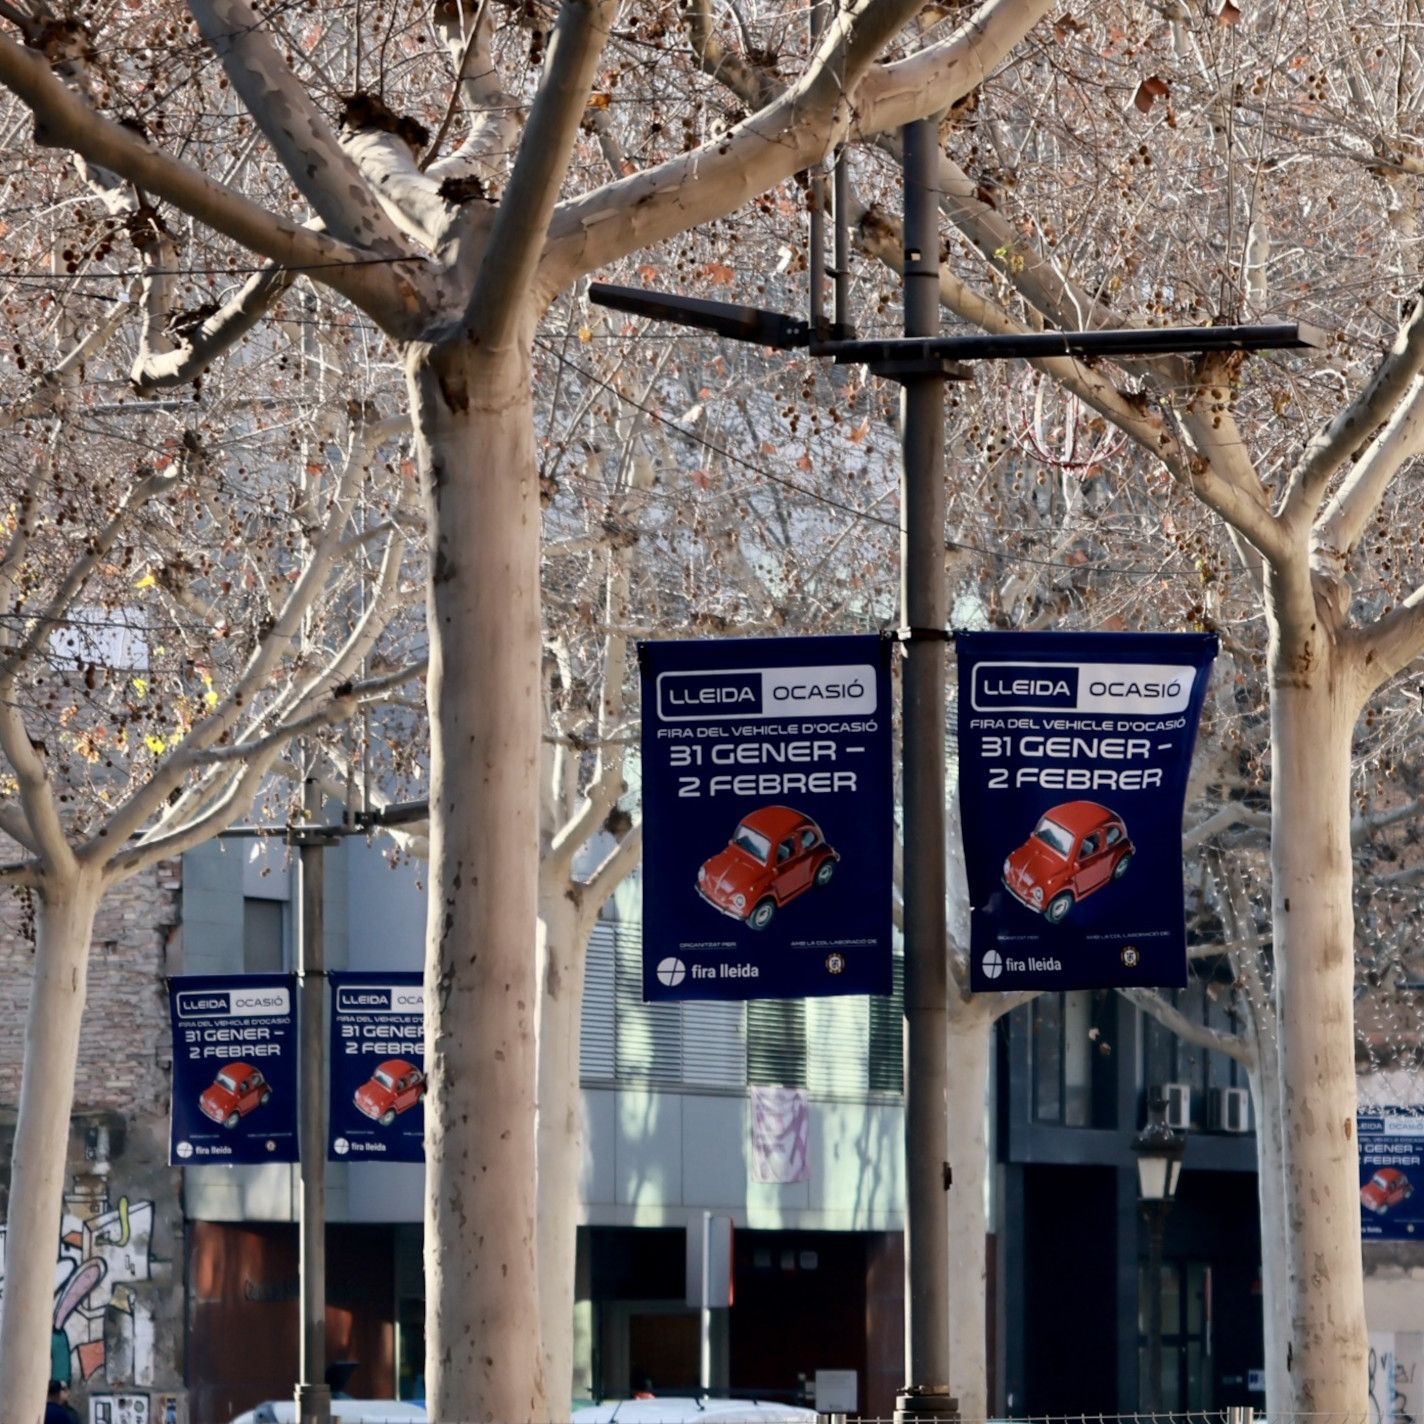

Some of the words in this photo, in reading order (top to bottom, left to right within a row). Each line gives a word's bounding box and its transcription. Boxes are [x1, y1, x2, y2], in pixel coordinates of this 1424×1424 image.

[669, 686, 756, 705] LLEIDA
[773, 679, 865, 701] OCASIÓ
[983, 679, 1071, 697] LLEIDA
[1089, 679, 1182, 699] OCASIÓ
[657, 727, 695, 739] FIRA
[697, 726, 729, 738] DEL
[731, 724, 799, 737] VEHICLE
[802, 719, 878, 734] D'OCASIÓ
[970, 718, 1005, 730] FIRA
[1007, 718, 1040, 730] DEL
[1042, 719, 1114, 732] VEHICLE
[1117, 716, 1187, 732] D'OCASIÓ
[669, 745, 702, 767] 31
[711, 740, 837, 765] GENER
[981, 736, 1012, 758] 31
[1019, 735, 1151, 759] GENER
[678, 776, 701, 798] 2
[709, 771, 858, 797] FEBRER
[988, 768, 1009, 789] 2
[1016, 767, 1163, 791] FEBRER
[691, 964, 716, 979] fira
[720, 963, 759, 979] lleida
[1006, 957, 1026, 972] fira
[1028, 956, 1062, 972] lleida
[183, 999, 227, 1010] LLEIDA
[235, 995, 283, 1008] OCASIÓ
[342, 995, 388, 1005] LLEIDA
[185, 1030, 201, 1042] 31
[204, 1028, 270, 1042] GENER
[341, 1025, 360, 1037] 31
[189, 1047, 200, 1059] 2
[204, 1044, 281, 1059] FEBRER
[345, 1042, 358, 1054] 2
[362, 1042, 425, 1055] FEBRE
[1365, 1144, 1413, 1153] GENER
[1364, 1156, 1420, 1165] FEBRER
